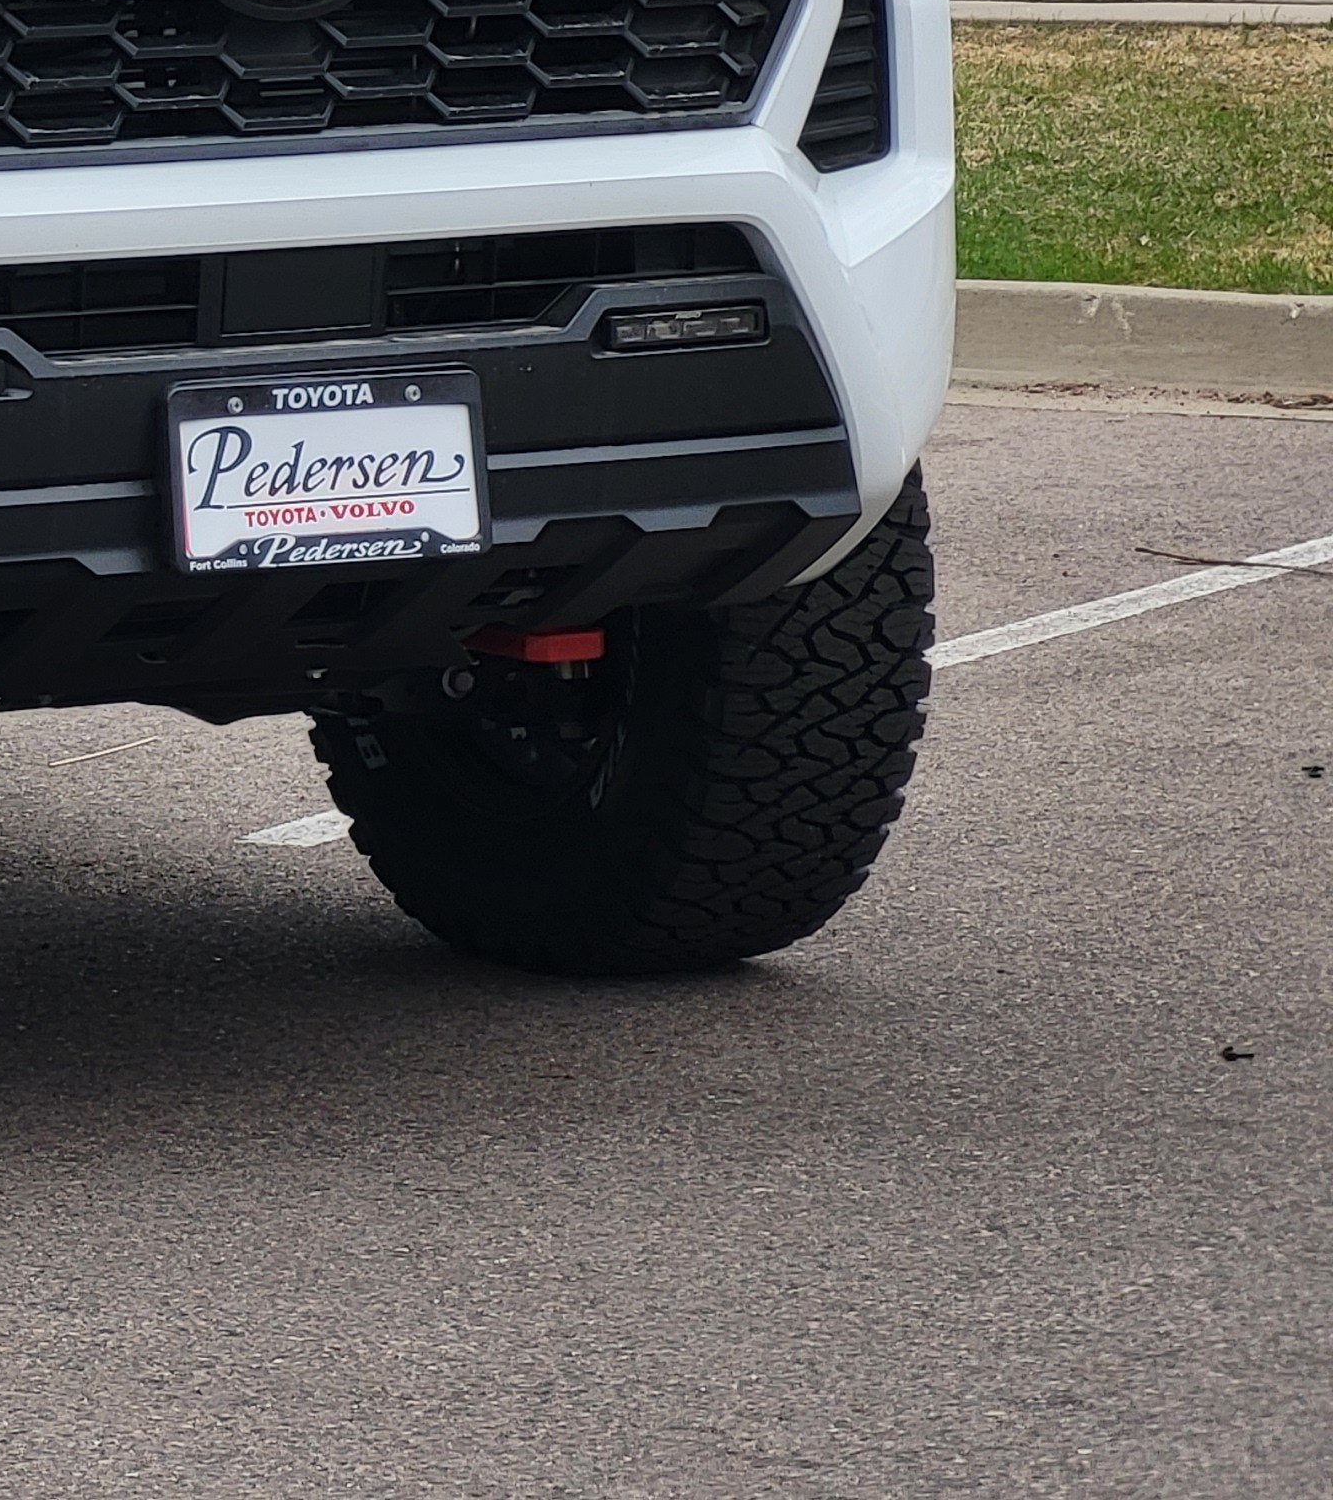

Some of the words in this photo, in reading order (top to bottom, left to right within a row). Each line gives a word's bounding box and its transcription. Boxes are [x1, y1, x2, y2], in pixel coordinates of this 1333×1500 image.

[272, 383, 374, 410] TOYOTA
[188, 425, 465, 511] Pedersen
[244, 509, 317, 528] TOYOTA
[332, 499, 415, 521] VOLVO
[253, 532, 423, 569] Pedersen
[440, 542, 481, 554] Colorado
[190, 560, 212, 572] Fort
[213, 557, 248, 571] Collins
